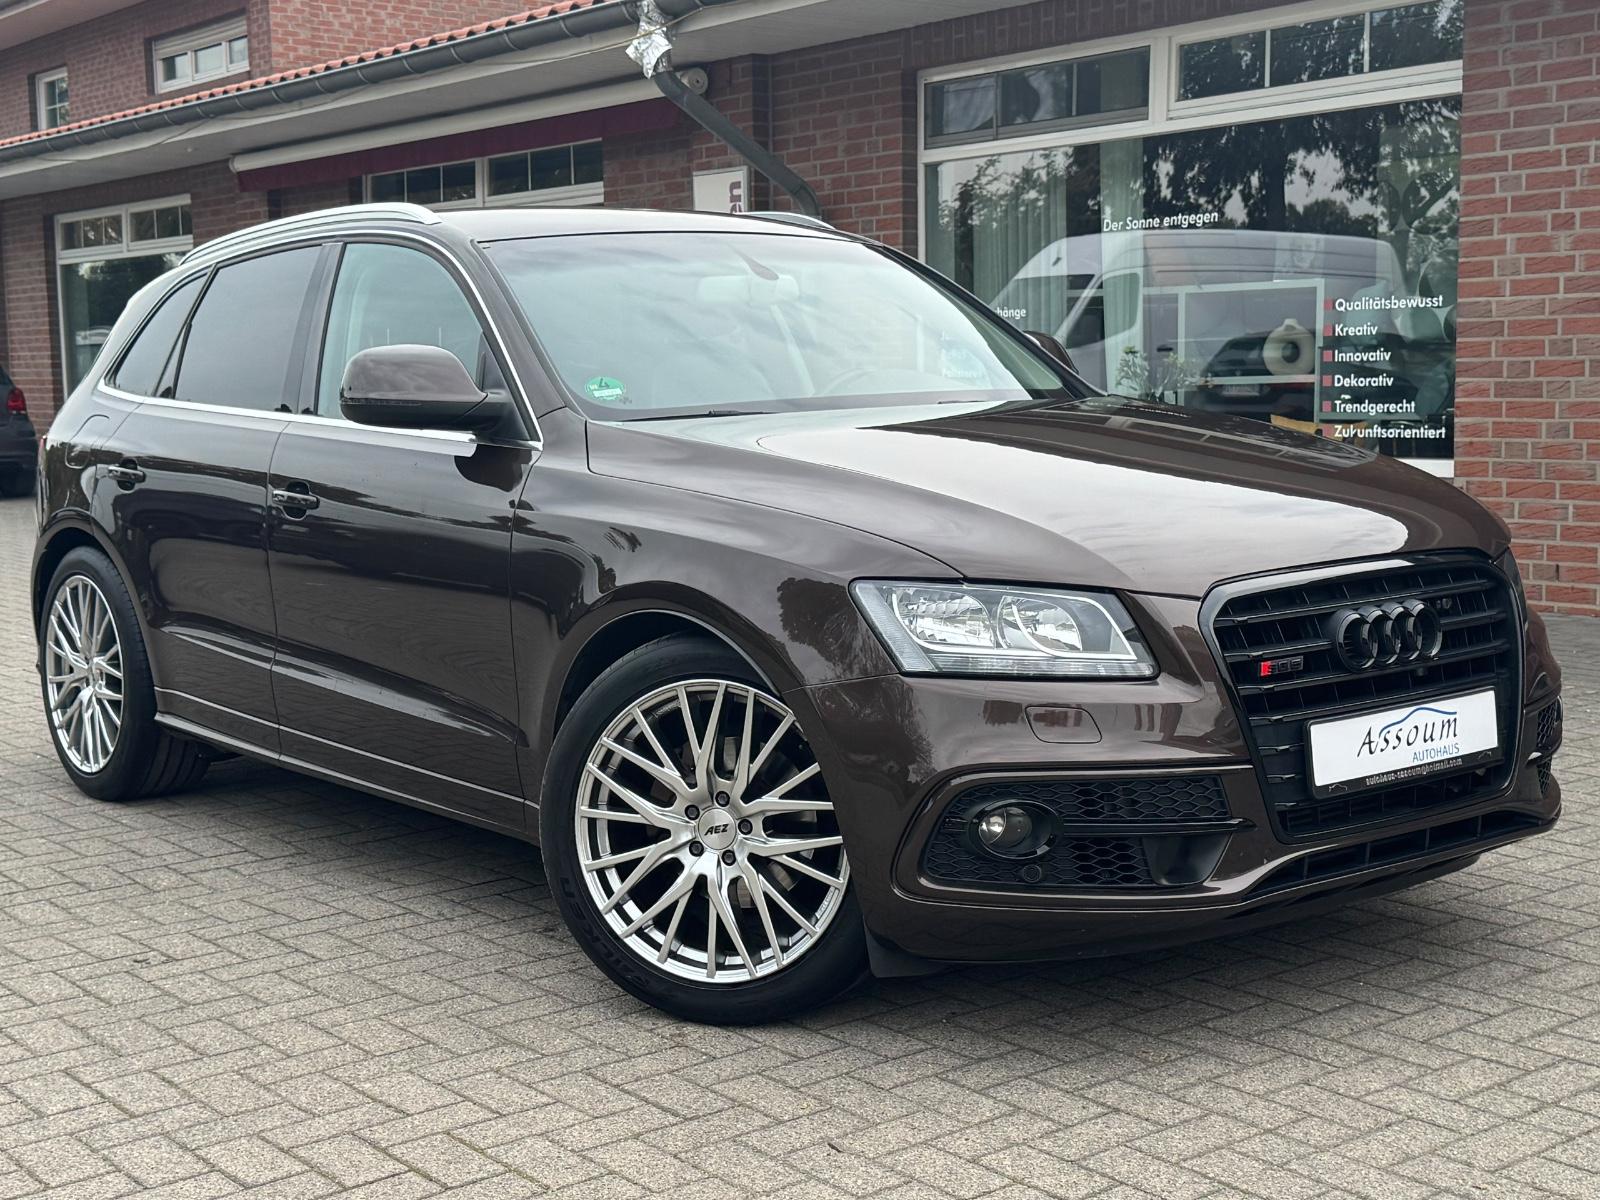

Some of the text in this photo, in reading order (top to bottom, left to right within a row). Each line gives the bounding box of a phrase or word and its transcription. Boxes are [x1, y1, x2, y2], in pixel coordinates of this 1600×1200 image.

[1103, 211, 1219, 232] Der Sonne entgegen
[1335, 295, 1443, 313] Qualitätsbewusst
[994, 306, 1027, 320] hänge
[1334, 322, 1378, 337] Kreativ
[1334, 347, 1392, 362] Innovativ
[1334, 373, 1394, 387] Dekorativ
[1334, 399, 1416, 416] Trendgerecht
[1334, 424, 1446, 439] Zukunftsorientiert
[1357, 717, 1458, 758] Assoum
[1412, 742, 1461, 763] AUTOHAUS
[704, 823, 729, 837] AEZ
